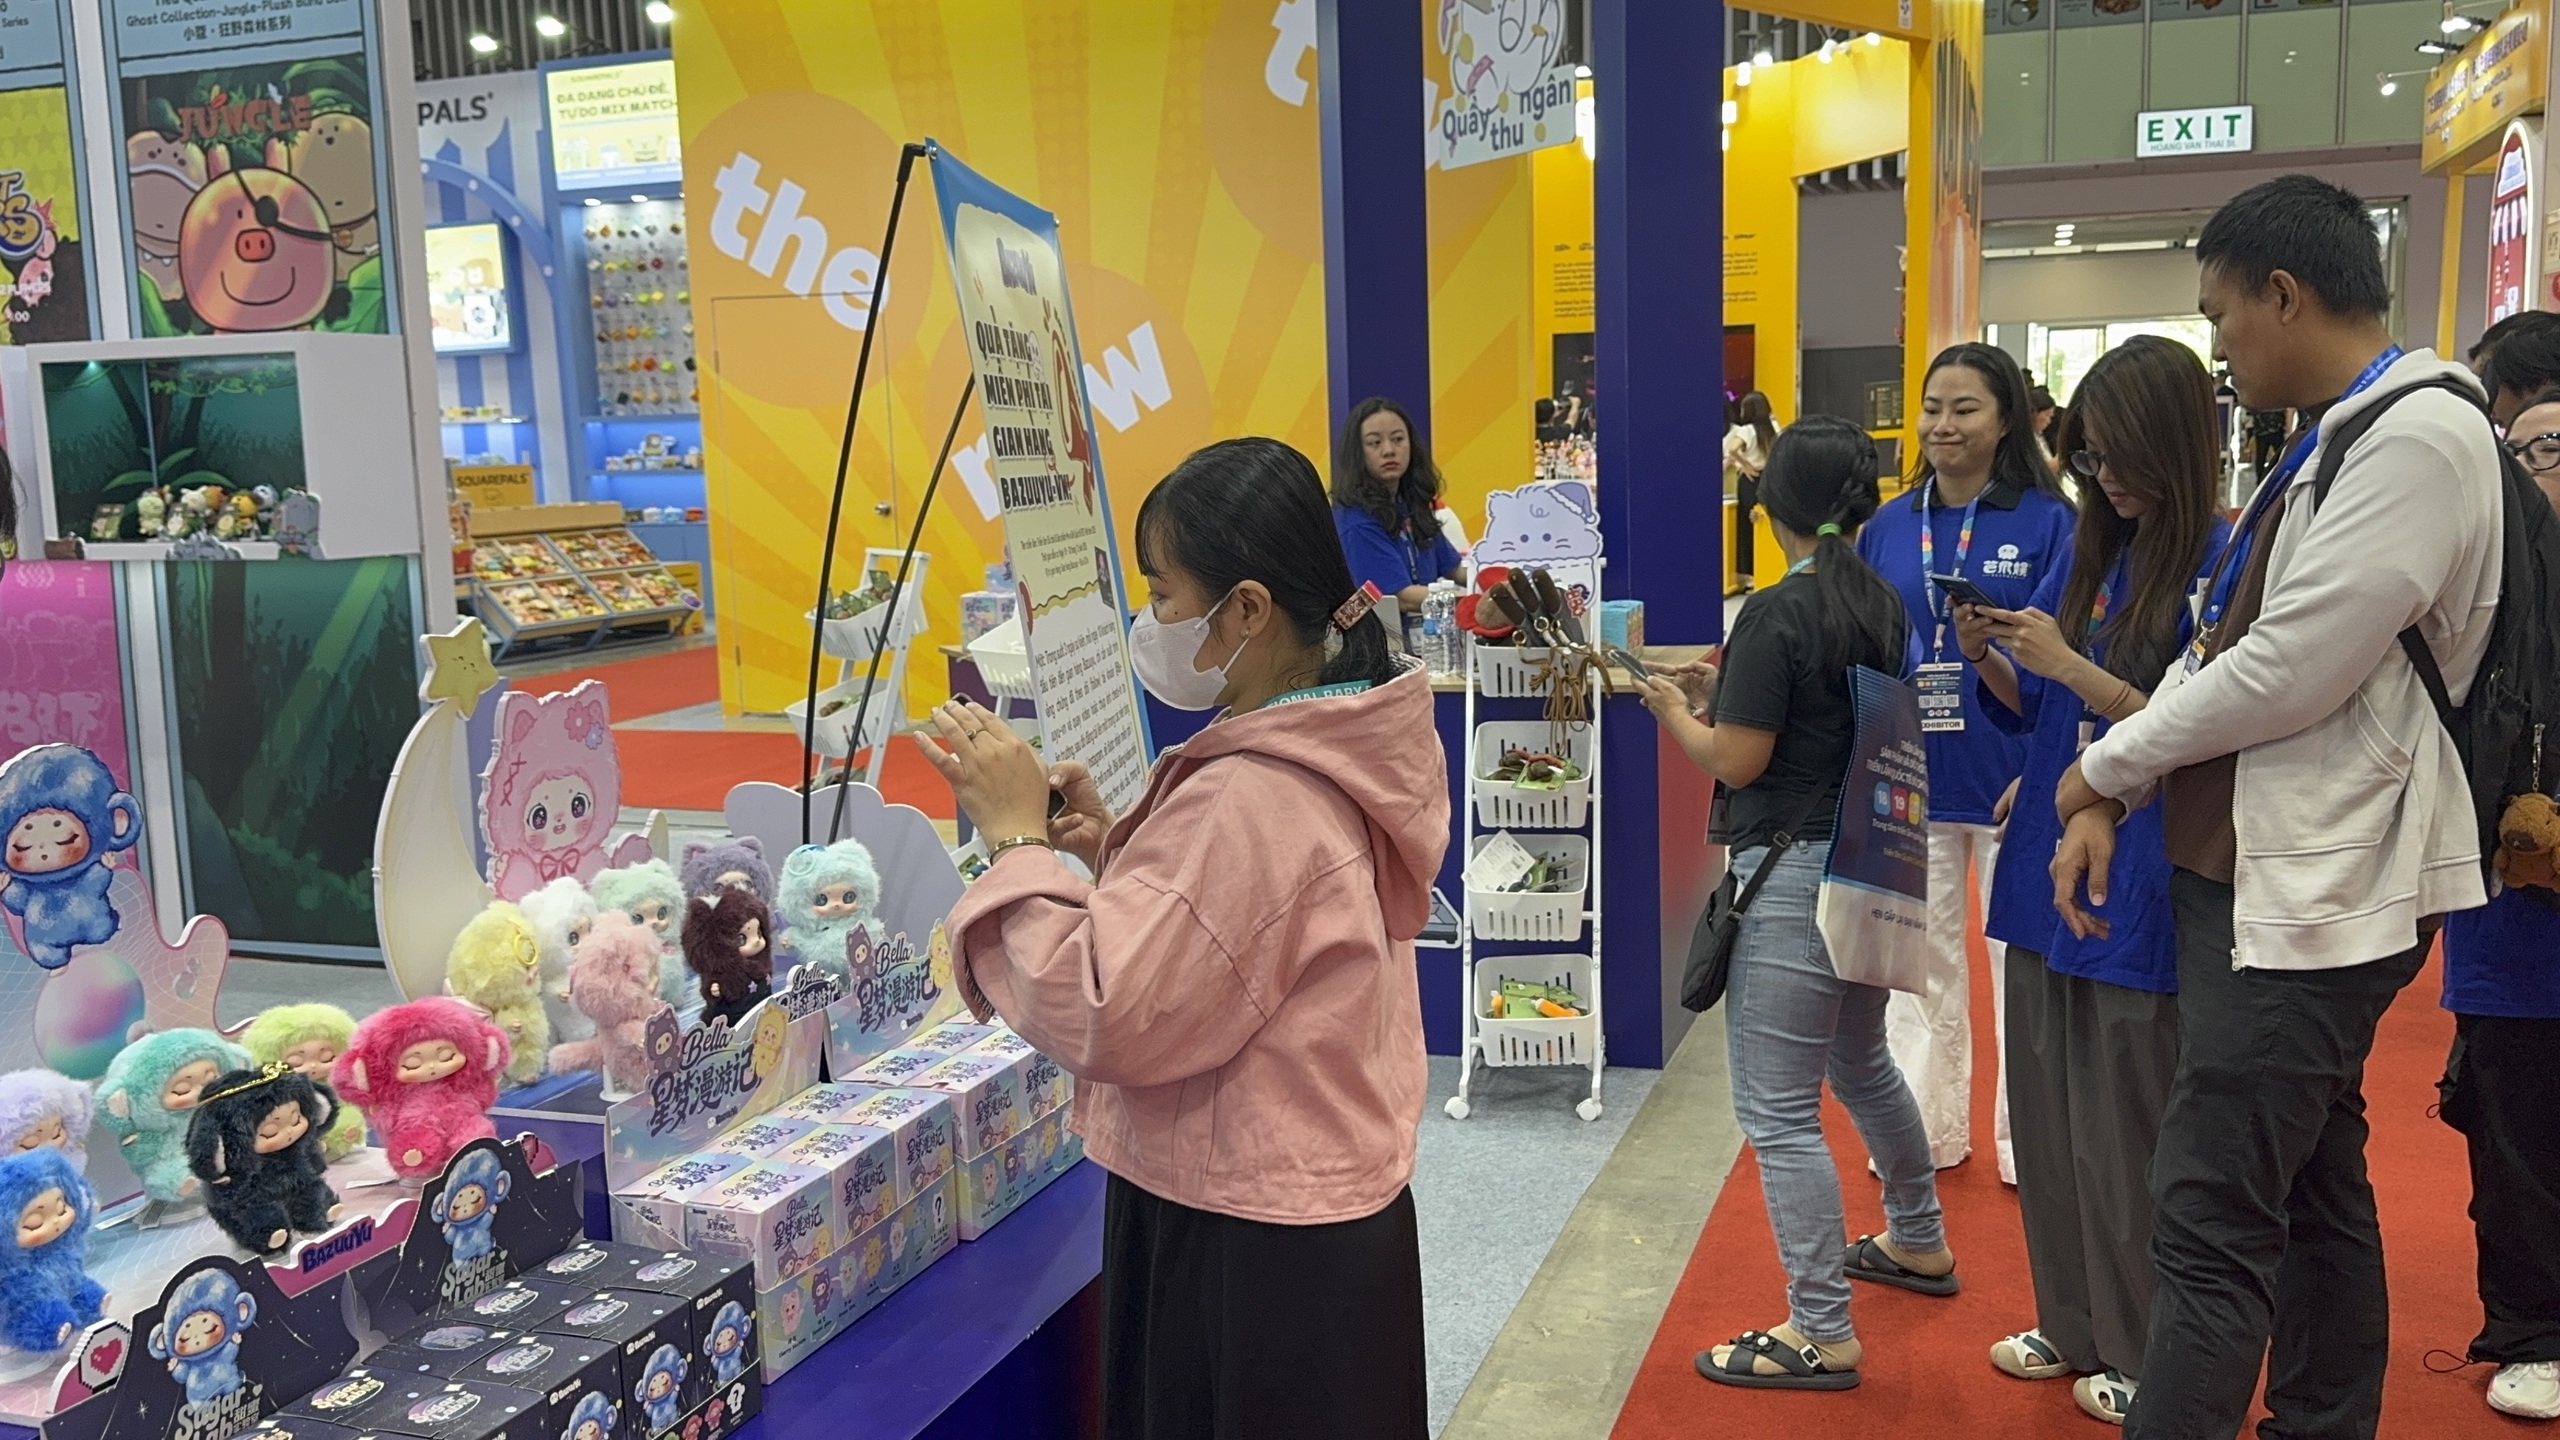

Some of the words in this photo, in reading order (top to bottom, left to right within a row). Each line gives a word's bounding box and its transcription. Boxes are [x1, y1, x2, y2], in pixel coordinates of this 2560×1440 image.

[126, 15, 158, 27] Ghost
[177, 94, 312, 143] JUNGLE
[601, 102, 626, 114] MIX
[1443, 95, 1491, 145] Quầy
[1490, 117, 1524, 151] thu
[1520, 73, 1571, 121] ngân
[2147, 114, 2242, 142] EXIT
[2150, 141, 2182, 152] HOANG
[2184, 140, 2202, 150] VAN
[2204, 139, 2224, 149] THAI
[711, 152, 890, 331] the
[976, 305, 1004, 362] QUÀ
[1015, 362, 1036, 410] PHÍ
[993, 425, 1026, 458] GIAN
[1023, 409, 1055, 458] HÀNG
[1877, 789, 1888, 805] 18
[1893, 795, 1905, 810] 19
[793, 962, 827, 994] Bella
[876, 937, 914, 978] Bella
[680, 1020, 734, 1071] Bella
[441, 1250, 496, 1298] Sugar
[174, 1386, 247, 1440] Sugar
